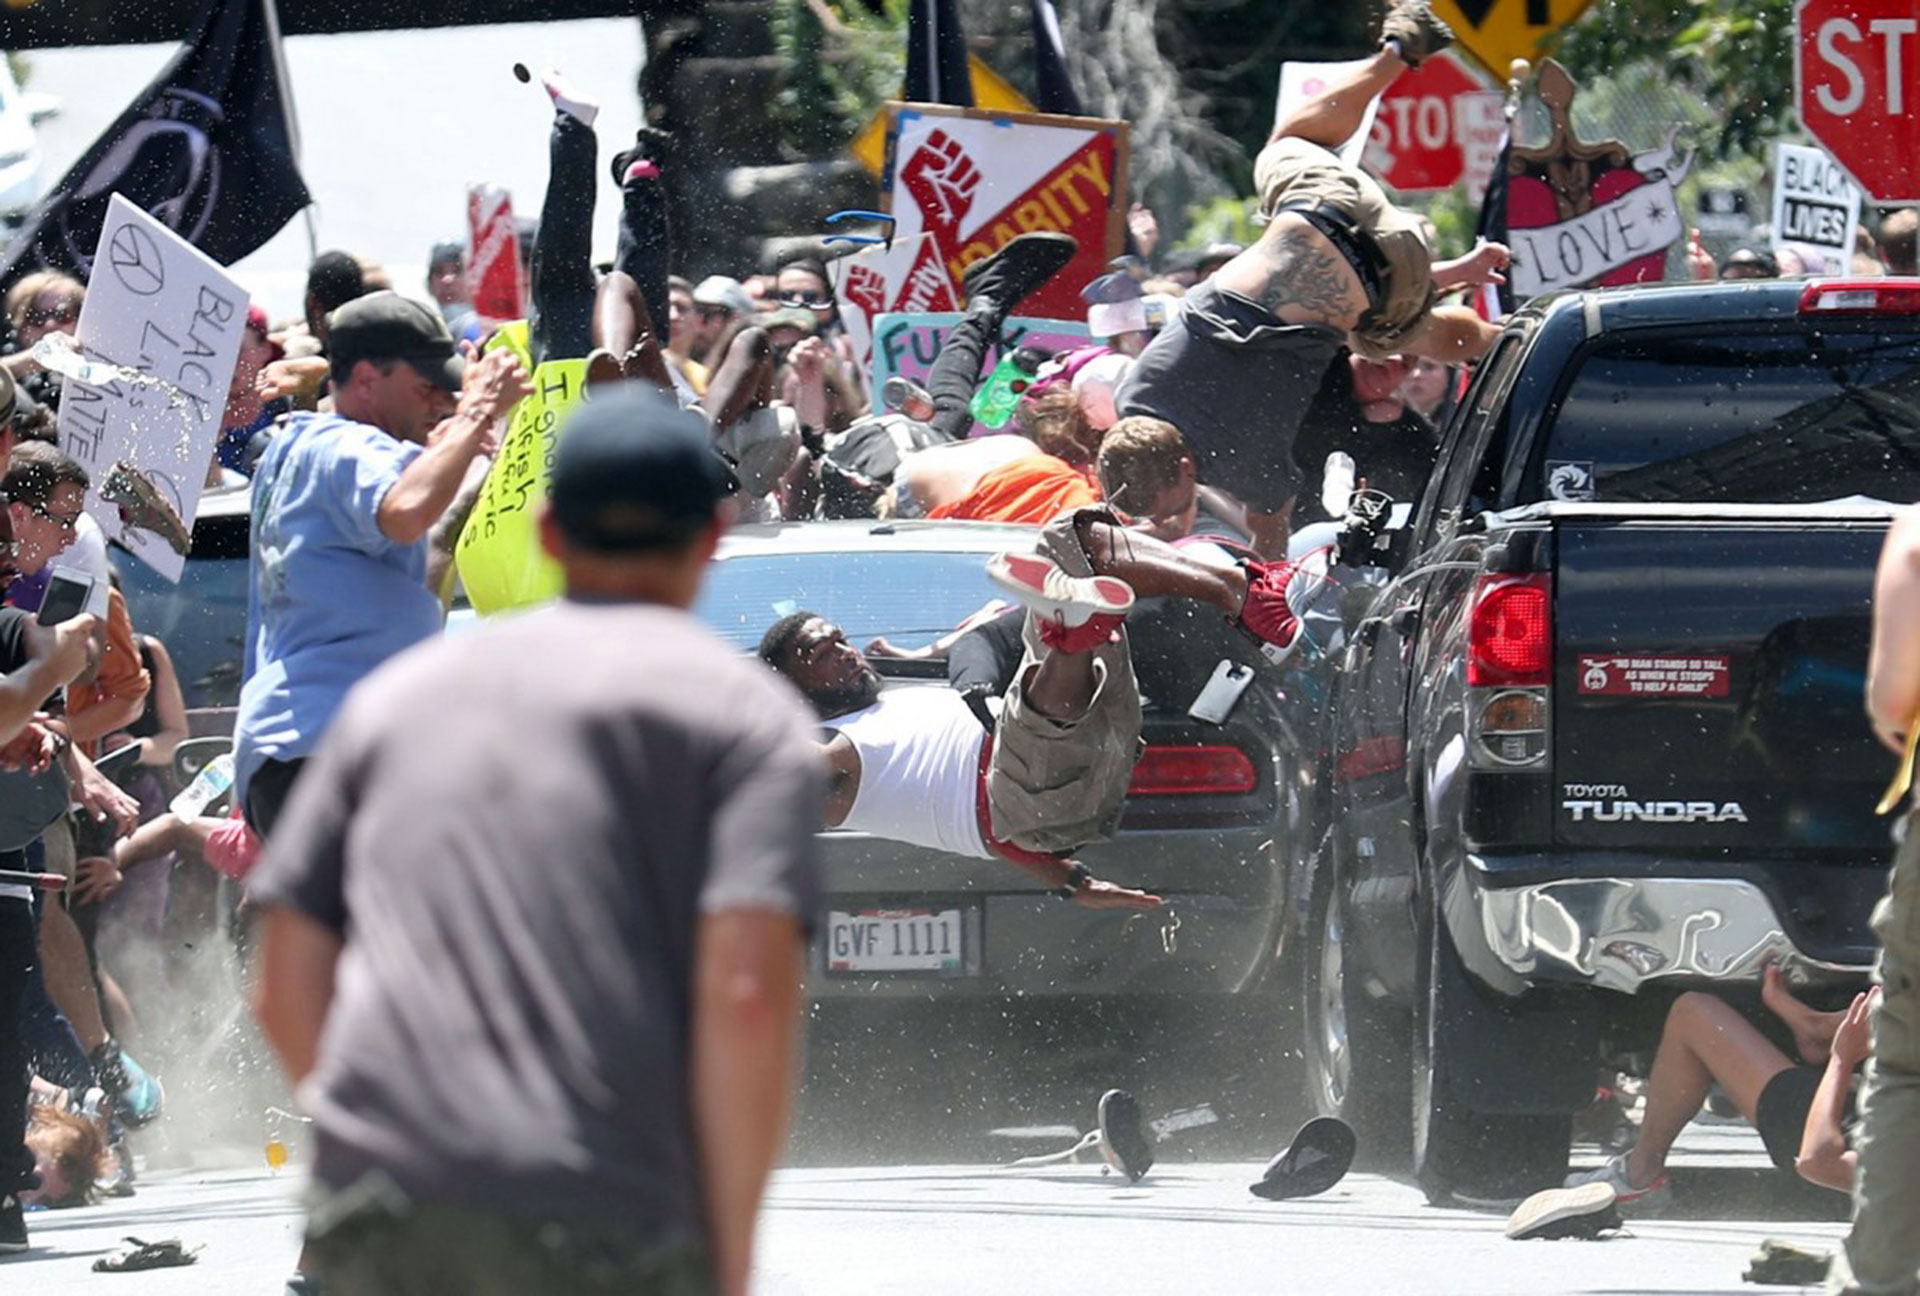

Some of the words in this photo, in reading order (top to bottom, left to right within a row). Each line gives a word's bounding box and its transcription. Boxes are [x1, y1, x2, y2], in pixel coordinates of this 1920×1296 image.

[1816, 18, 1917, 116] ST
[1525, 201, 1650, 284] LOVE
[1784, 203, 1846, 243] LIVES
[168, 285, 234, 423] BLACK
[882, 322, 1028, 373] FUK
[66, 346, 124, 463] MATTE
[515, 402, 535, 511] elfish
[1625, 670, 1637, 680] AS
[1654, 659, 1687, 670] STANDS
[1630, 681, 1643, 691] TO
[1644, 681, 1668, 692] HELP
[1668, 682, 1676, 691] A
[1563, 784, 1628, 798] TOYOTA
[1562, 801, 1749, 823] TUNDRA
[834, 923, 880, 957] GVF
[892, 920, 951, 956] 1111
